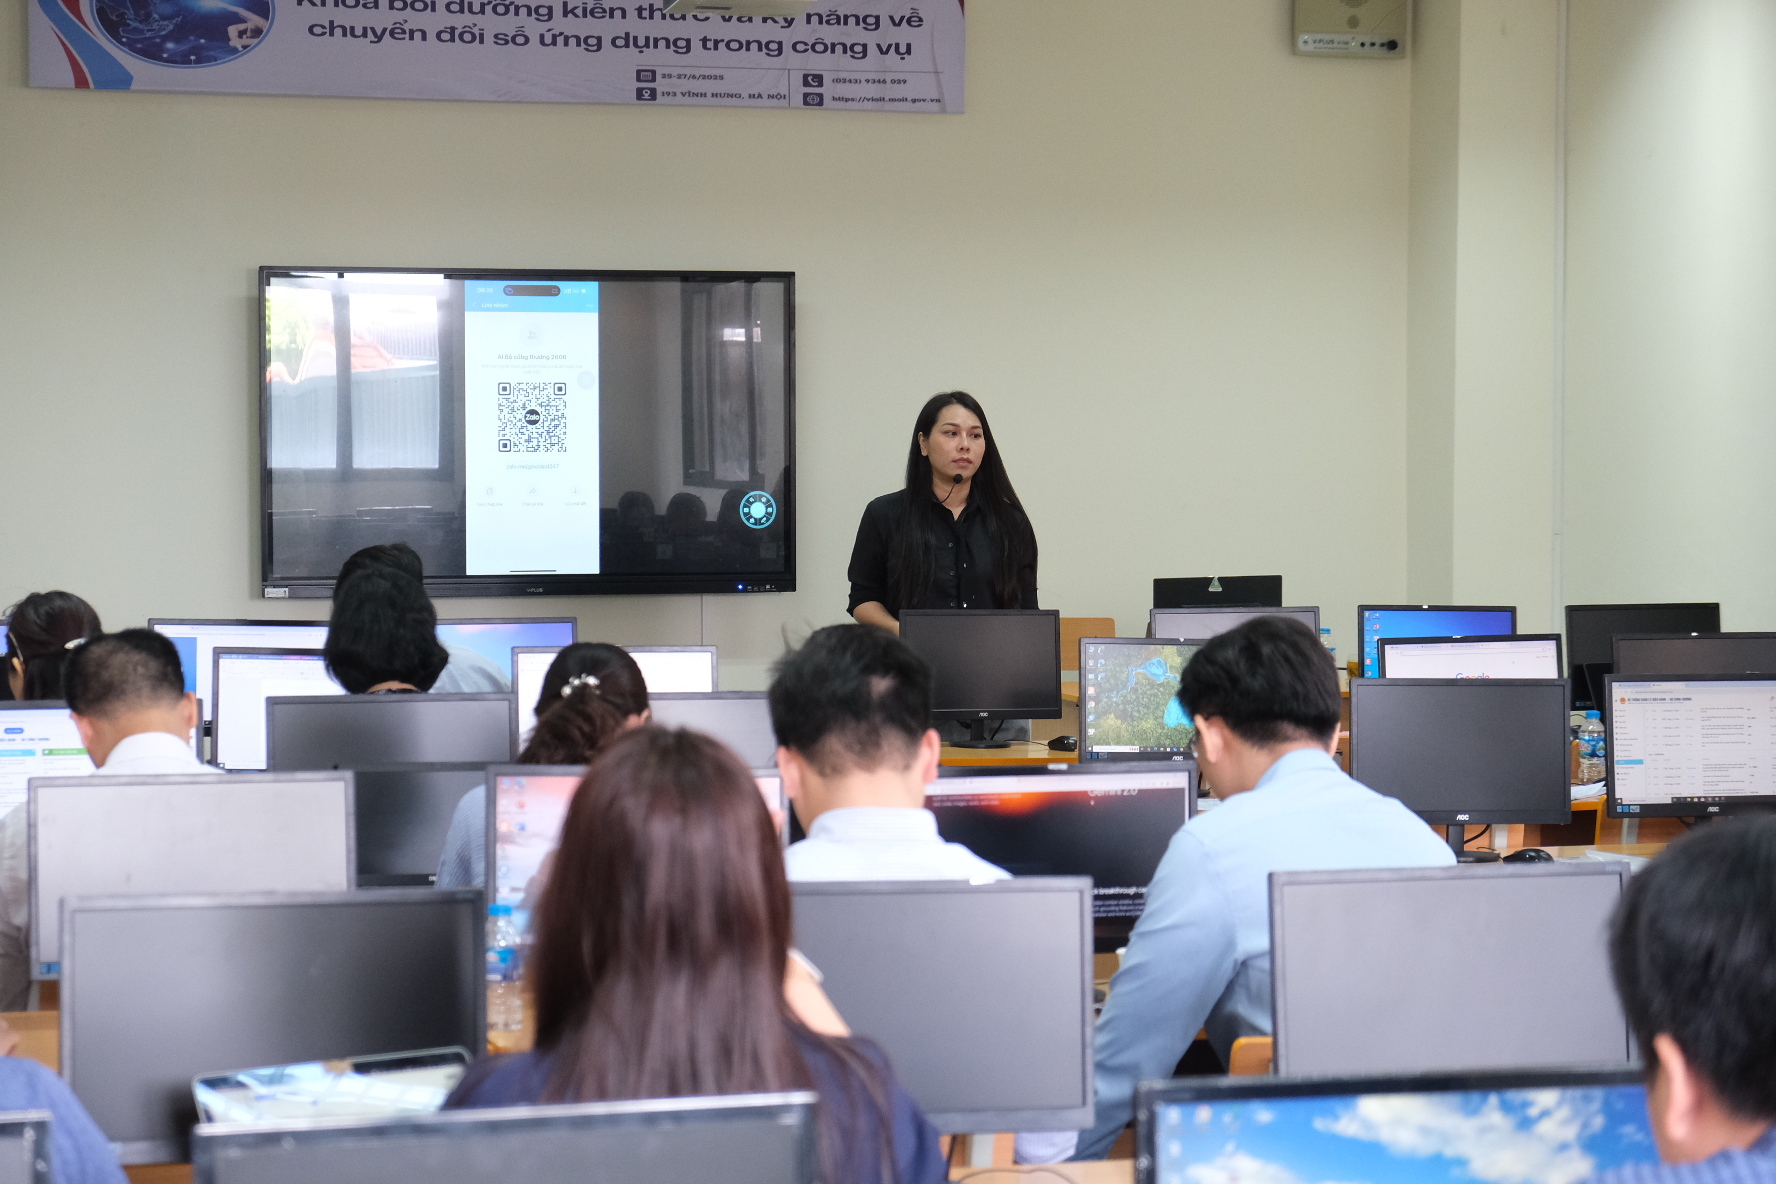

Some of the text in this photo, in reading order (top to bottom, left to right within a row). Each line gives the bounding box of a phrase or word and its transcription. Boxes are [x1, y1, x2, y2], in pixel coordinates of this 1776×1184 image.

[806, 9, 880, 31] năng
[888, 7, 924, 27] về
[308, 19, 912, 60] chuyển đổi số ứng dụng trong công vụ
[661, 73, 724, 81] 25-27/6/2025
[680, 91, 708, 99] VĨNH
[748, 92, 764, 100] HÀ
[767, 92, 787, 101] NỘI
[525, 413, 540, 421] Zalo
